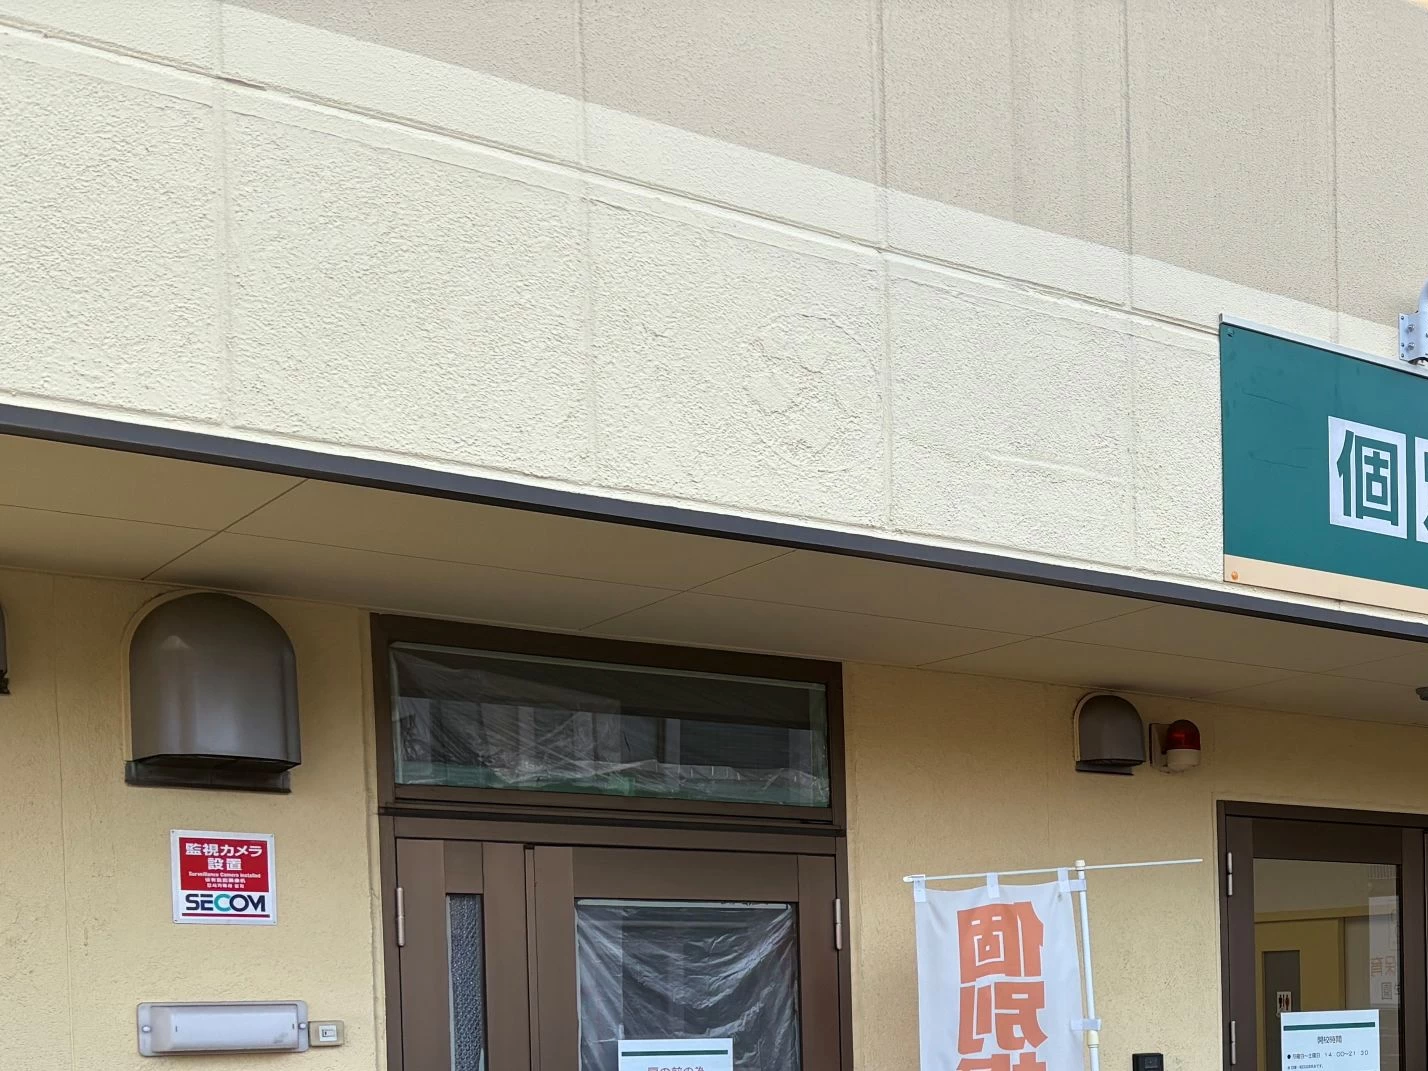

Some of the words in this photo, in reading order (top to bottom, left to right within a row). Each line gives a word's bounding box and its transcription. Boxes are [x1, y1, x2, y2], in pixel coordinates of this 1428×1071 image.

[185, 843, 262, 857] 監視カメラ
[207, 857, 242, 871] 設置
[185, 893, 266, 912] SECOM
